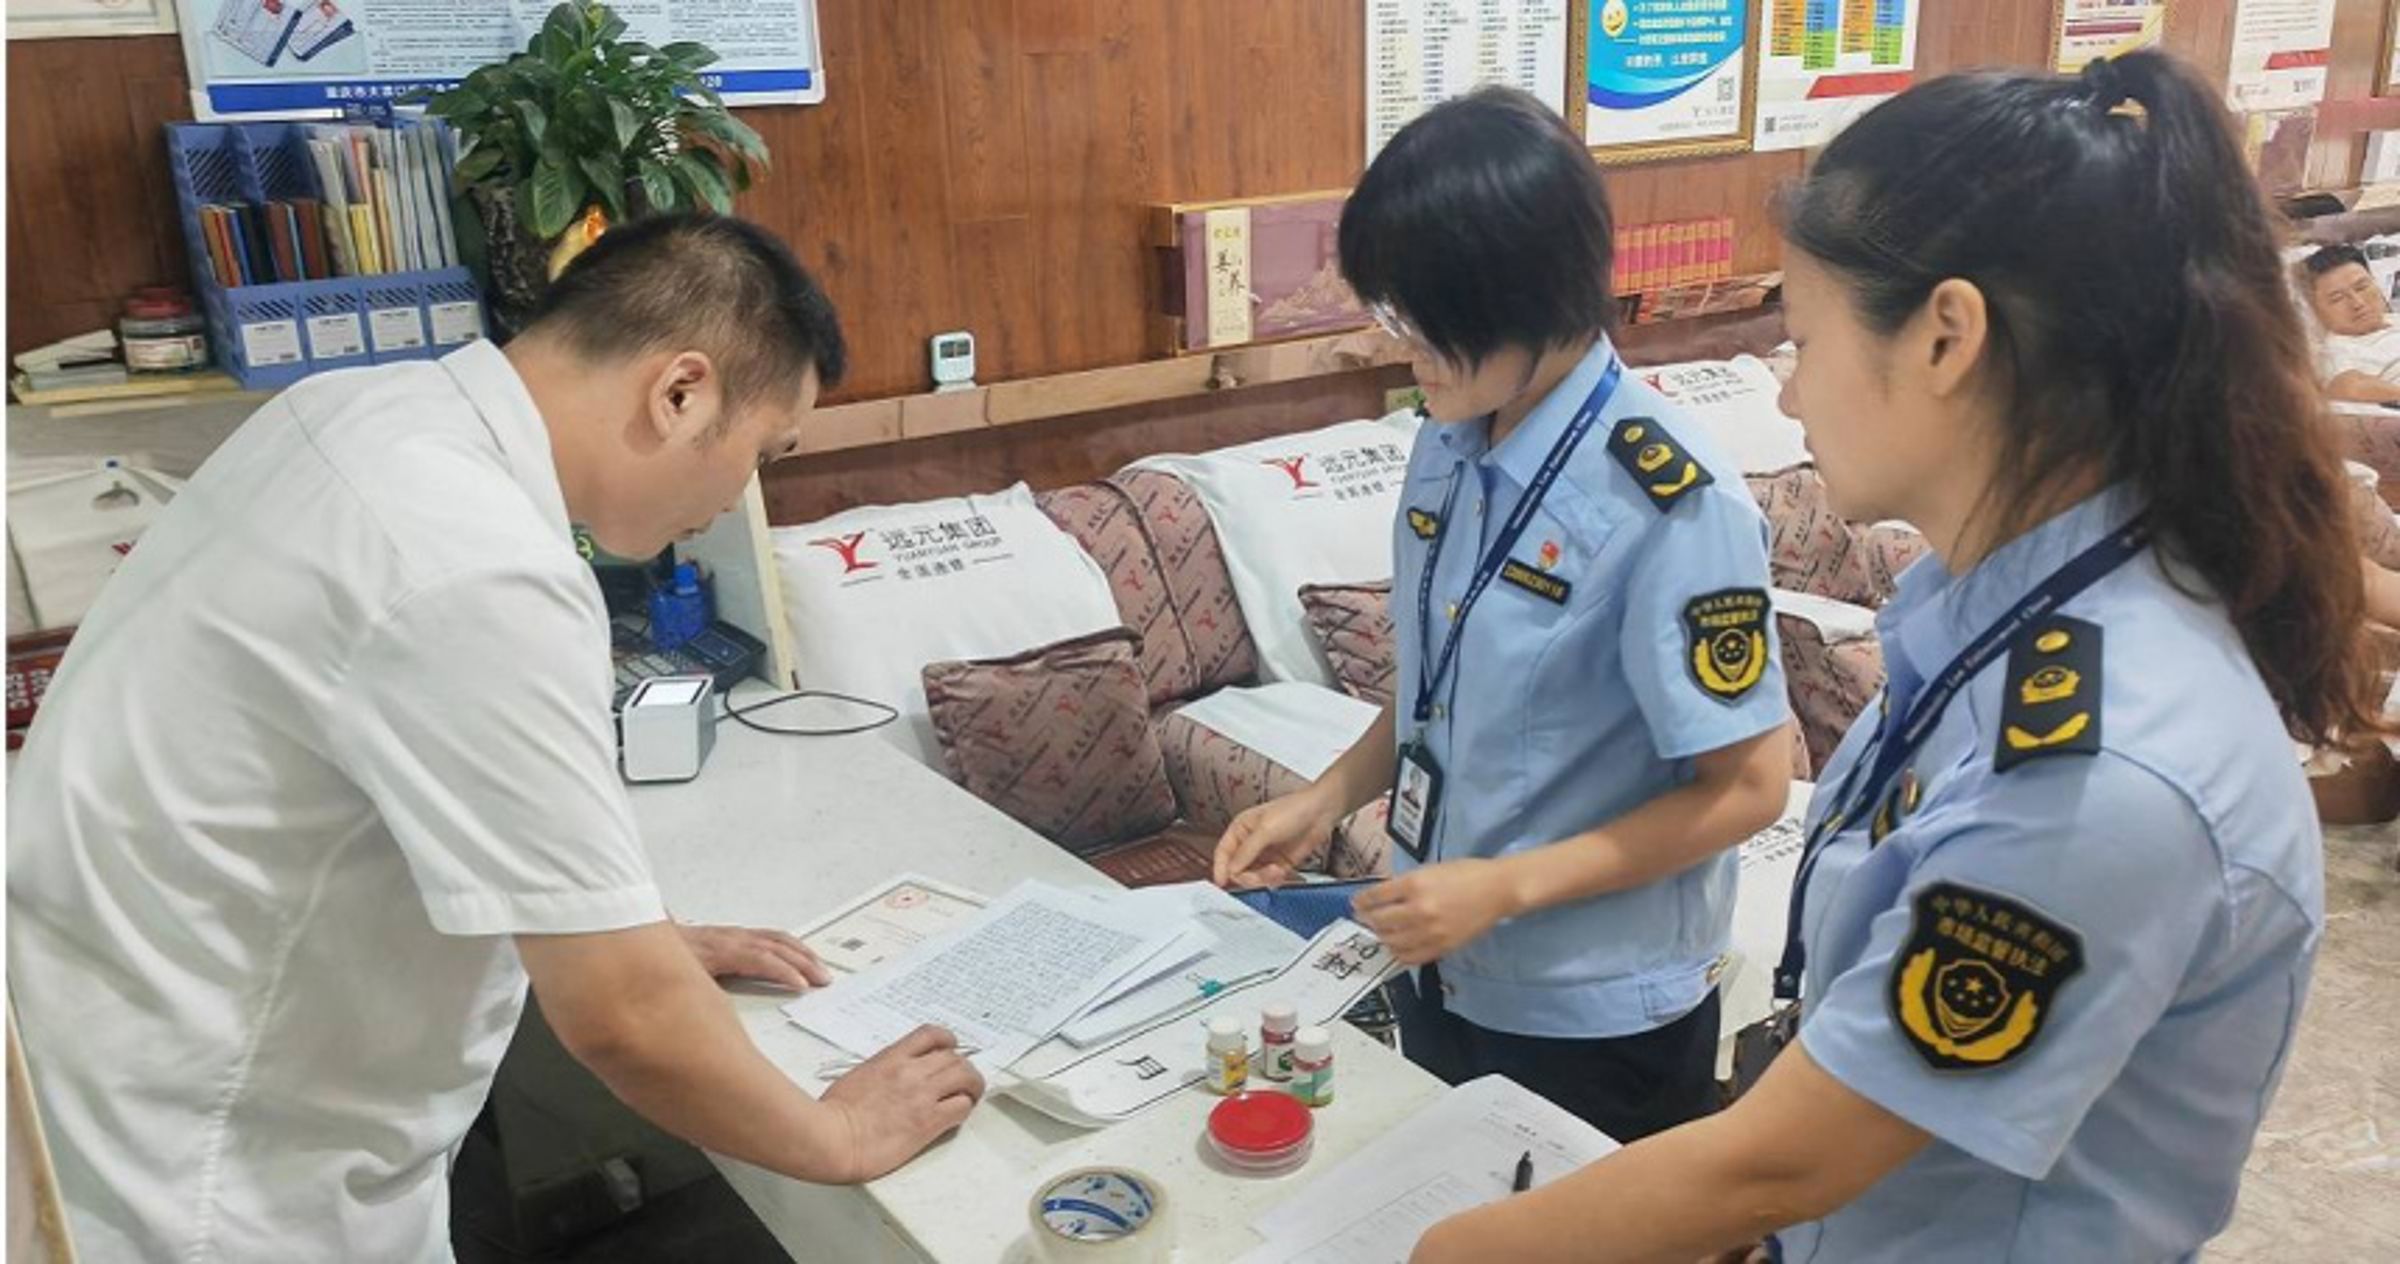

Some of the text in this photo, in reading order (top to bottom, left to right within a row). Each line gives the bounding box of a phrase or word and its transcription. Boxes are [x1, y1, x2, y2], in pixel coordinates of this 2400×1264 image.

[1318, 444, 1405, 474] 远元集团
[880, 515, 997, 550] 远元集团
[1115, 1055, 1168, 1081] 月
